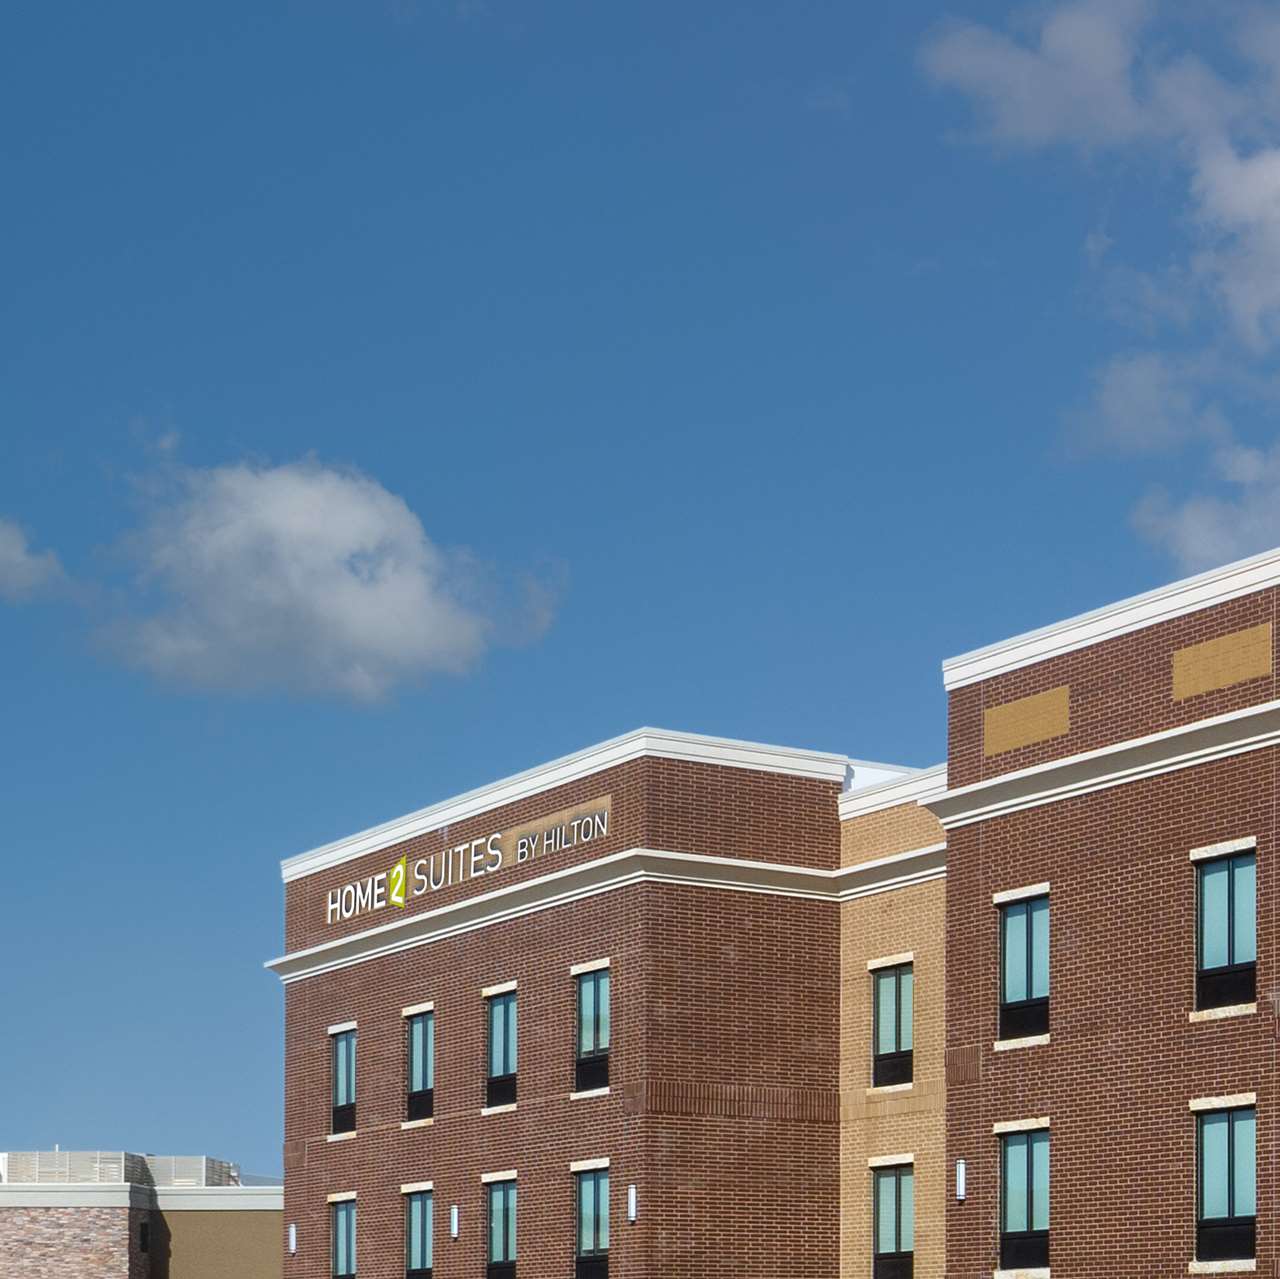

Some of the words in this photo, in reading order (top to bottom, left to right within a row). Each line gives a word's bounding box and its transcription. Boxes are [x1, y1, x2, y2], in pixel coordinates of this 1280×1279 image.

[413, 833, 503, 896] SUITES
[518, 834, 539, 863] BY
[543, 811, 609, 854] HILTON
